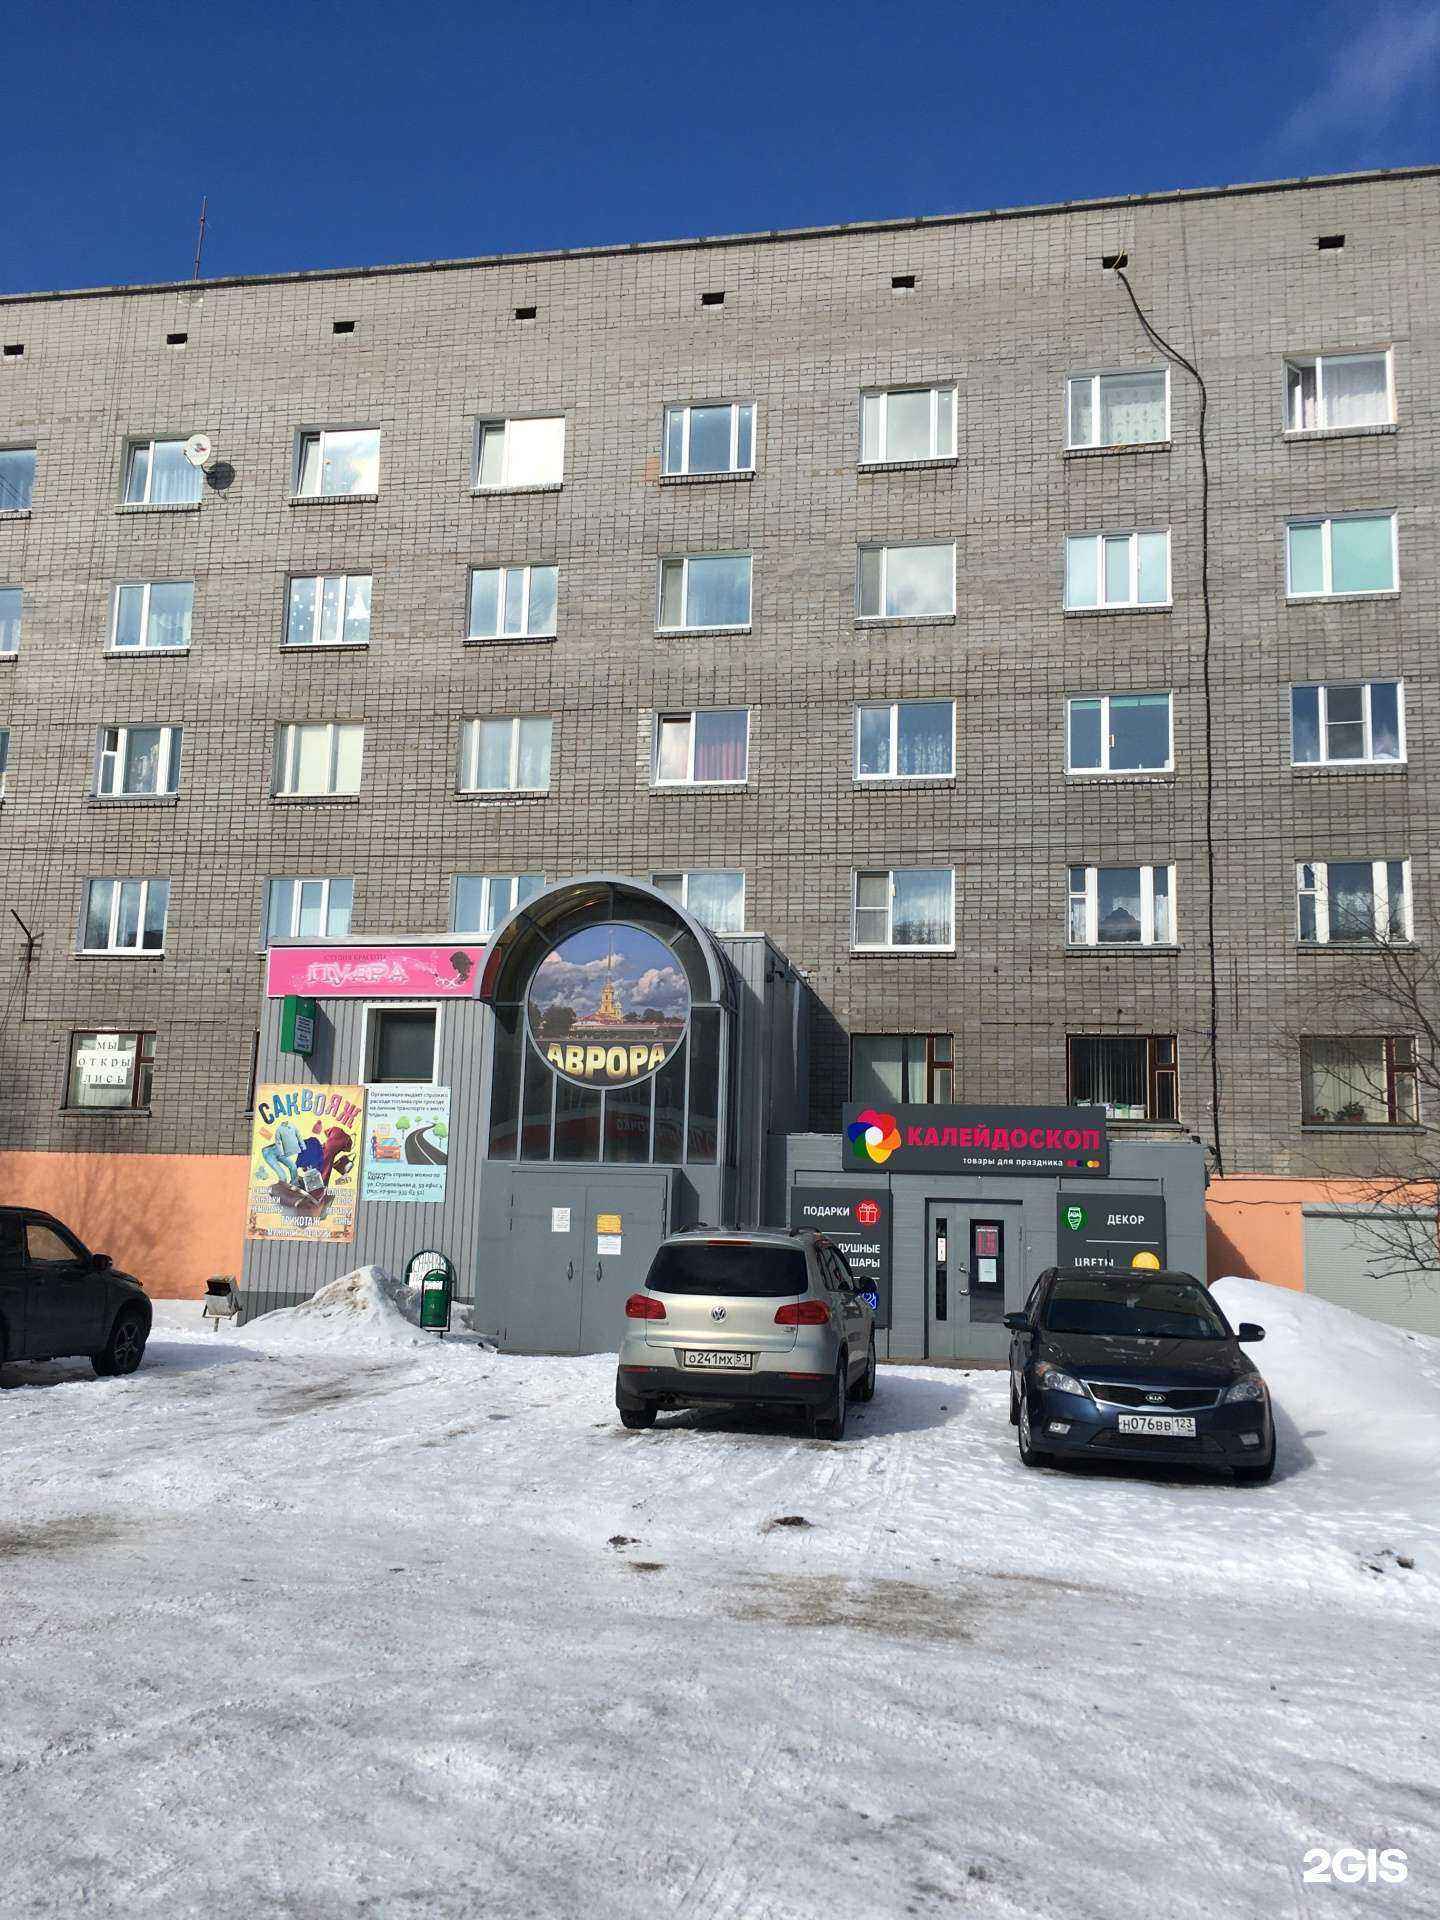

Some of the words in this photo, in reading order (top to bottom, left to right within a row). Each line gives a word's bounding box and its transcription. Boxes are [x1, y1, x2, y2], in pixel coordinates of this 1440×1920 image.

[97, 1041, 117, 1050] МЫ
[78, 1057, 131, 1067] ОТКРЫ
[546, 1042, 666, 1080] АВРОРА
[258, 1087, 362, 1129] САКВОЯЖ
[907, 1123, 1100, 1151] КАЛЕЙДОСКОП
[962, 1157, 995, 1167] товары
[997, 1158, 1014, 1167] для
[1016, 1159, 1064, 1168] праздника
[803, 1205, 850, 1217] ПОДАРКИ
[1106, 1214, 1145, 1226] ДЕКОР
[838, 1243, 881, 1254] ДУШНЫЕ
[849, 1258, 881, 1268] ШАРЫ
[1122, 1417, 1171, 1431] Н076ВВ
